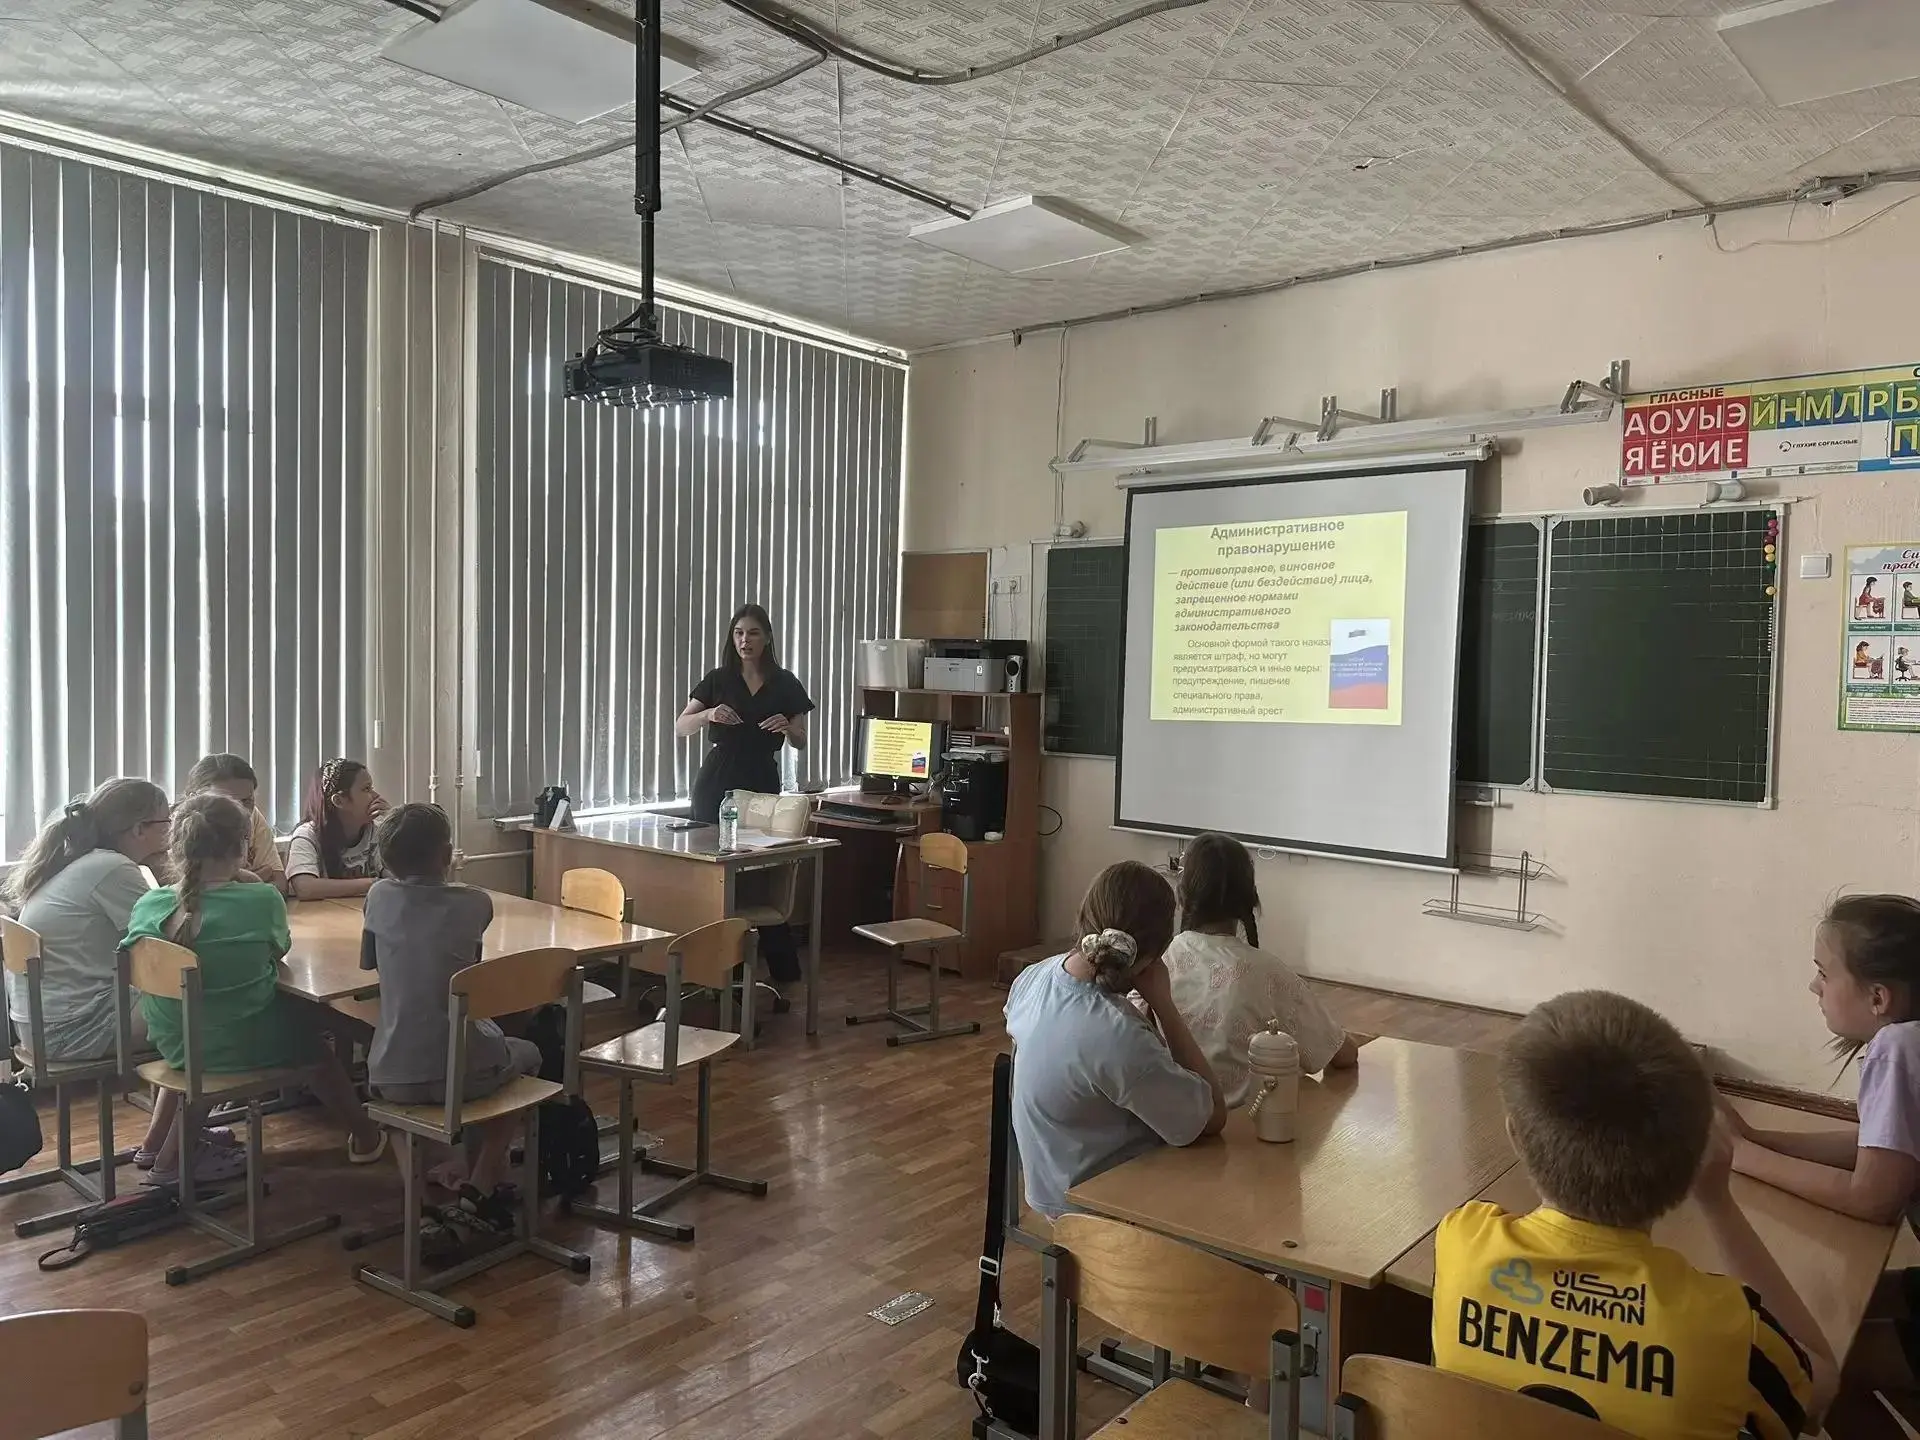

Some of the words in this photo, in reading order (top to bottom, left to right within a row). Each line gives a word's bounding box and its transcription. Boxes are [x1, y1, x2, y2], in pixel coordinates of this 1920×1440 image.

[1650, 387, 1724, 404] ГЛАСНЫЕ
[1210, 520, 1345, 540] Административное
[1217, 539, 1336, 558] правонарушение
[1180, 564, 1277, 578] противоправное,
[1279, 560, 1336, 572] виновное
[1175, 580, 1229, 591] действие
[1230, 579, 1254, 590] (или
[1257, 574, 1338, 589] бездействие)
[1339, 574, 1373, 585] лица,
[1175, 594, 1247, 606] запрещенное
[1249, 591, 1299, 603] нормами
[1174, 607, 1292, 620] административного
[1174, 621, 1280, 632] законодательства
[1187, 639, 1230, 648] Основной
[1231, 638, 1268, 649] формой
[1270, 638, 1300, 647] такого
[1173, 652, 1212, 661] является
[1214, 651, 1247, 662] штраф,
[1262, 651, 1288, 662] могут
[1173, 665, 1257, 674] предусматриваться
[1268, 664, 1292, 672] иные
[1173, 677, 1247, 687] предупреждение,
[1173, 691, 1232, 702] специального
[1234, 691, 1263, 701] права,
[1173, 705, 1256, 716] административный
[1258, 707, 1284, 716] арест
[1458, 1297, 1674, 1396] BENZEMA
